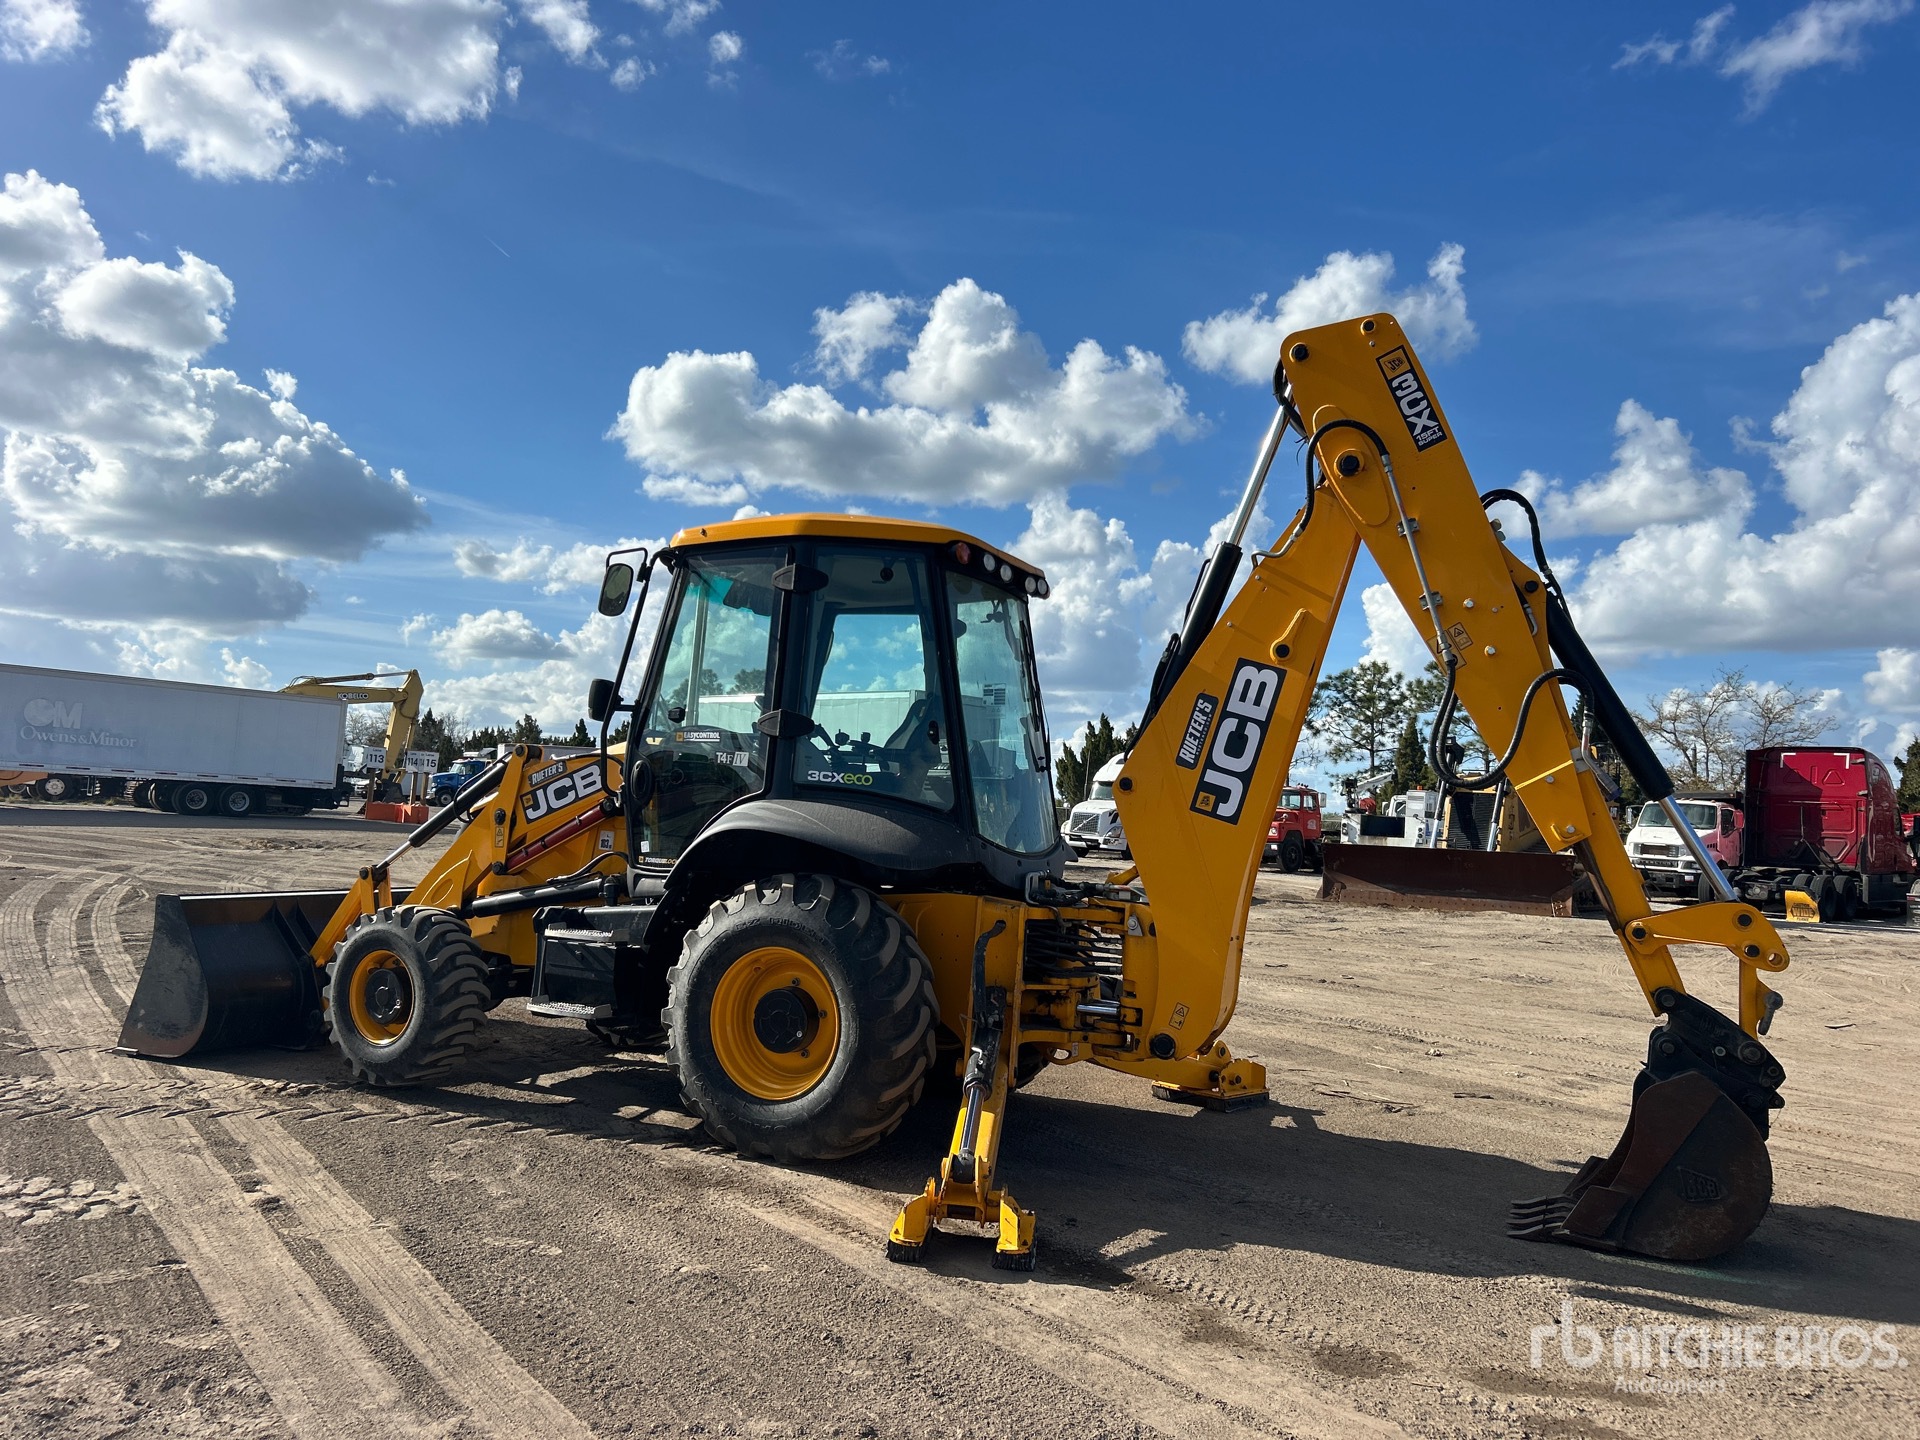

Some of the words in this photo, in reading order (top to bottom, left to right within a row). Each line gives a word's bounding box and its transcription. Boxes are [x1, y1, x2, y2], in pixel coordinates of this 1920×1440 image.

[1392, 372, 1439, 436] 3CX
[1415, 426, 1440, 441] 15FT
[337, 692, 369, 700] KOBELCO
[1179, 698, 1213, 764] RUETER'S
[1204, 665, 1279, 817] JCB
[369, 753, 385, 763] 113
[531, 762, 564, 785] RUETER'S
[525, 764, 603, 820] JCB
